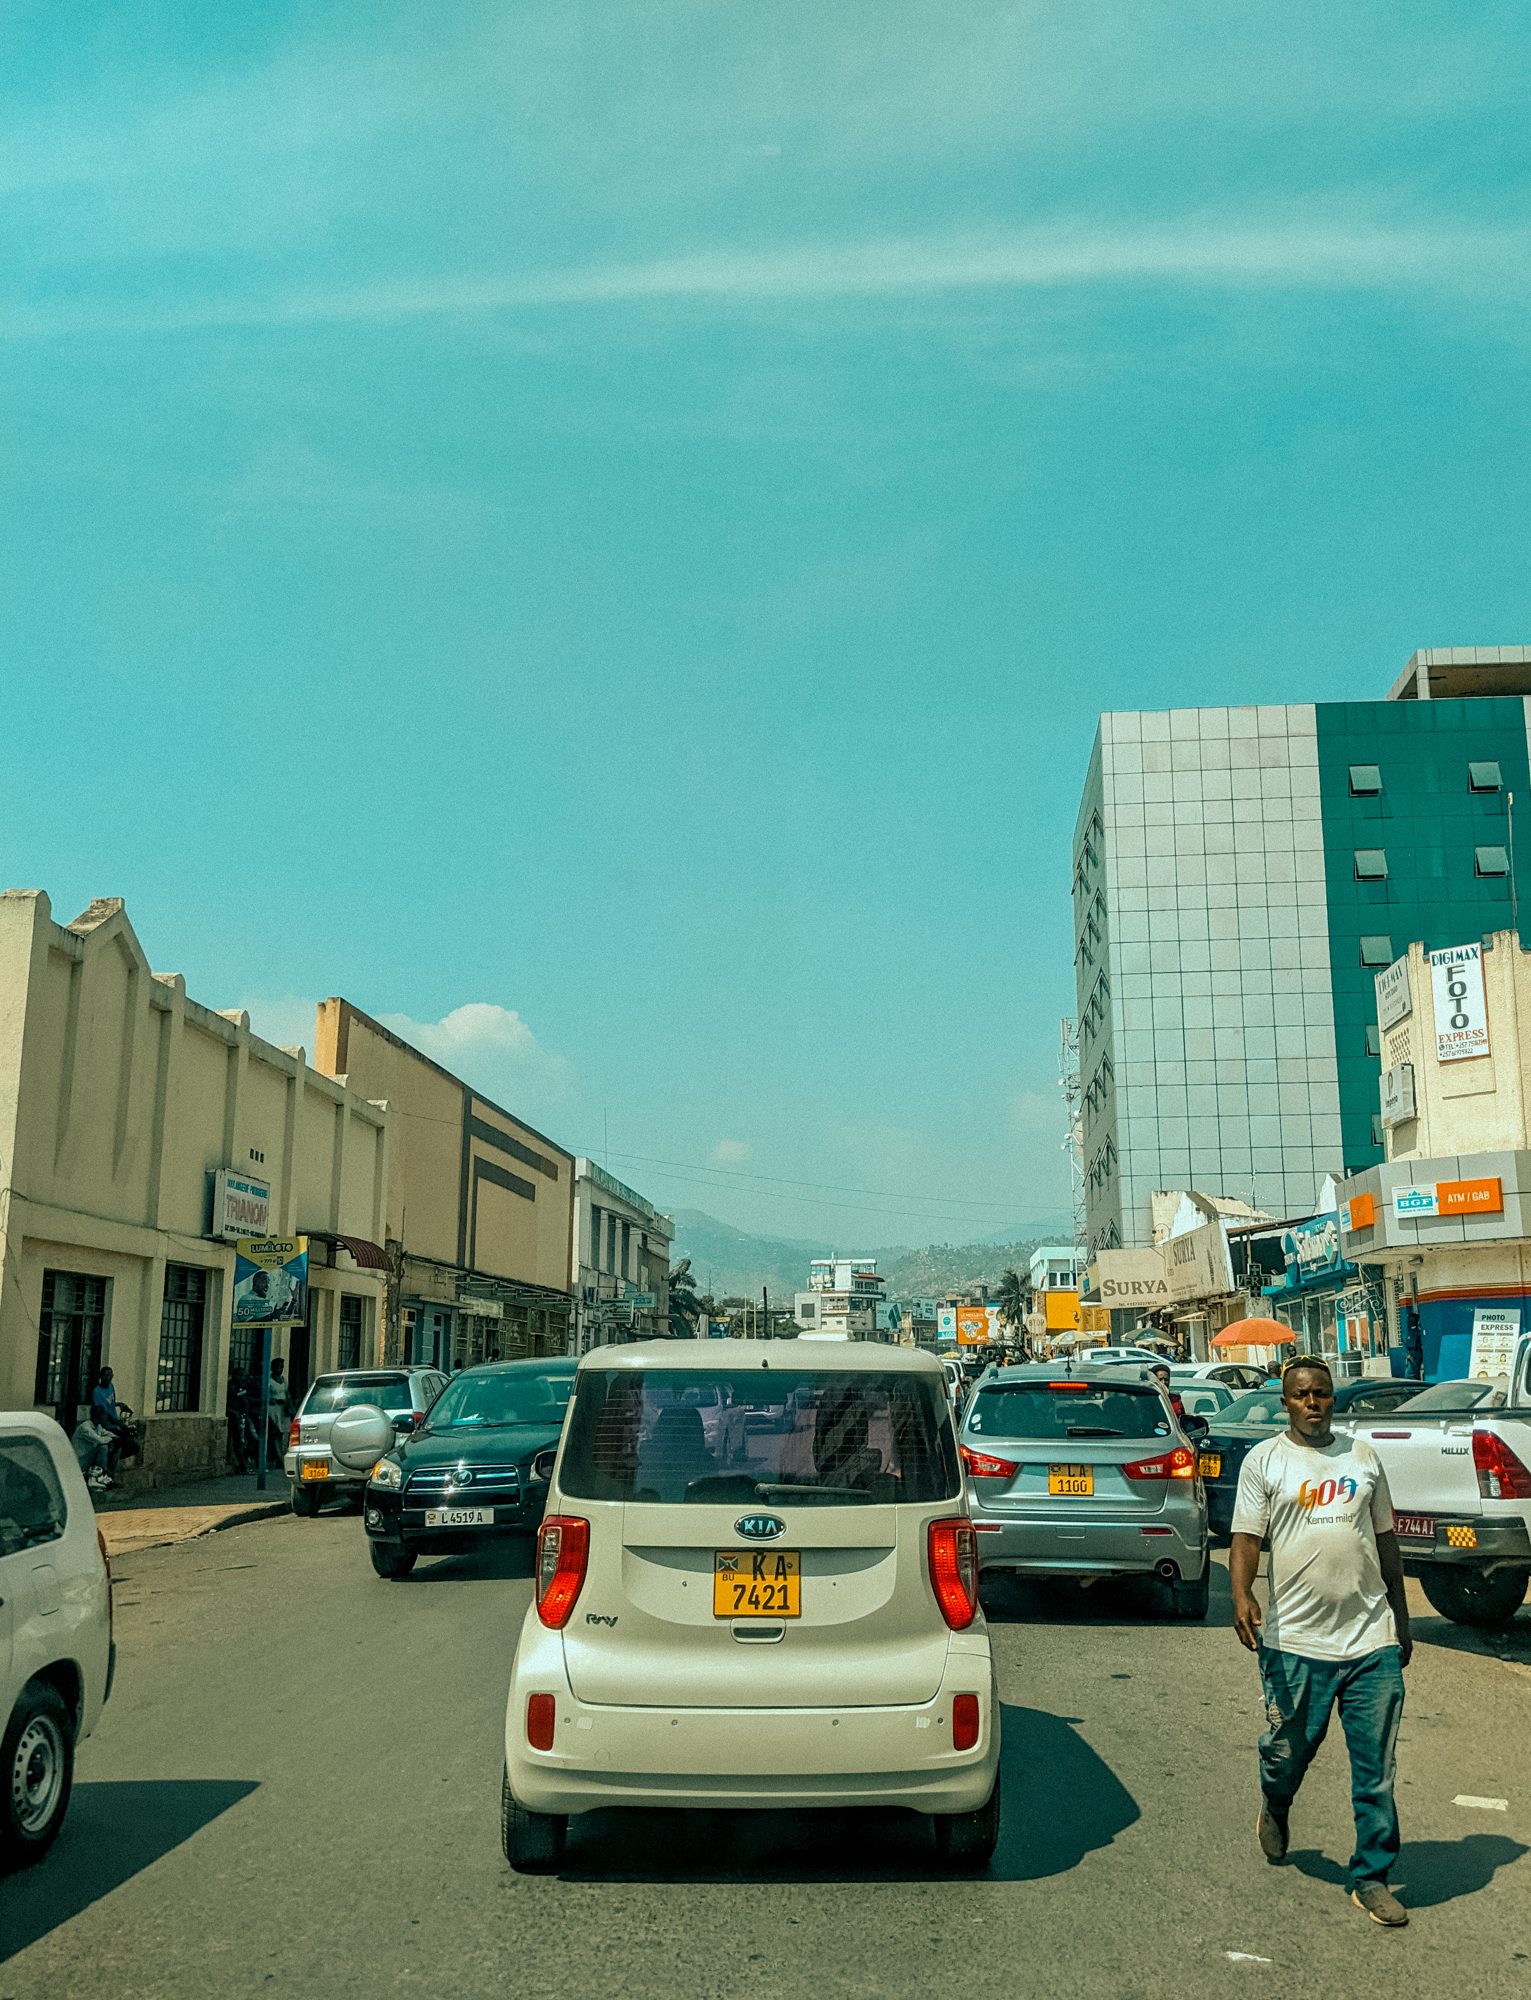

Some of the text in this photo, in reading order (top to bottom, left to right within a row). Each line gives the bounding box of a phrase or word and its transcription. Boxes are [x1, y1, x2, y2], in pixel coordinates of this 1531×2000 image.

[1446, 965, 1470, 1030] FOTO
[1439, 1029, 1485, 1044] EXPRESS
[1400, 1198, 1432, 1208] BGF
[1447, 1193, 1466, 1204] ATM
[1472, 1191, 1490, 1201] GAB
[1172, 1236, 1196, 1267] SURYA
[1102, 1279, 1168, 1297] SURYA
[237, 1307, 250, 1316] 50
[1028, 1319, 1045, 1327] STOP
[1441, 1447, 1469, 1455] HILUX
[1057, 1479, 1088, 1492] 1100
[450, 1512, 474, 1523] 4519
[744, 1520, 777, 1534] KIA
[722, 1573, 735, 1581] BU
[733, 1584, 790, 1610] 7421
